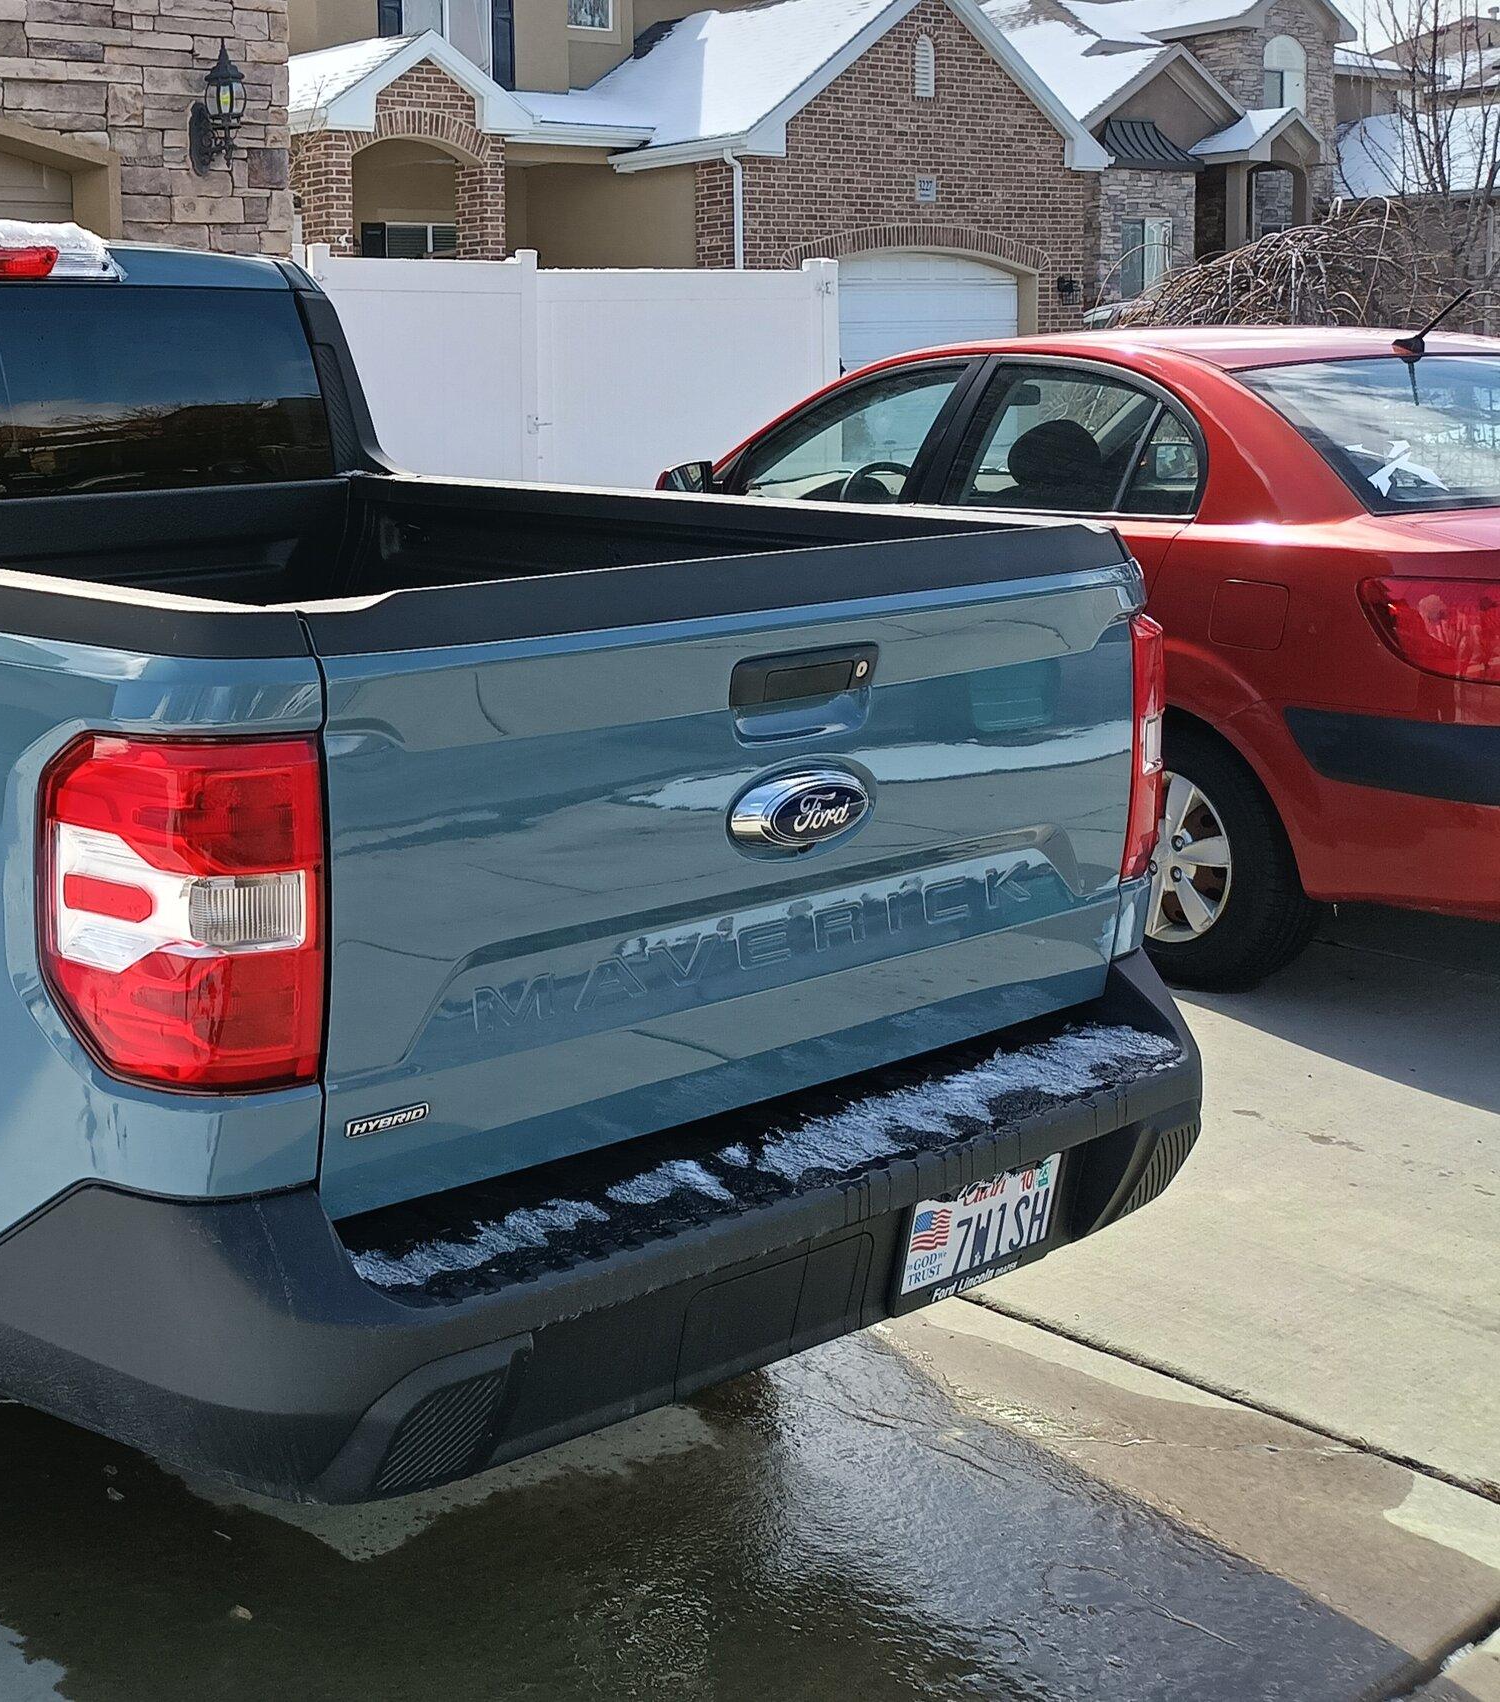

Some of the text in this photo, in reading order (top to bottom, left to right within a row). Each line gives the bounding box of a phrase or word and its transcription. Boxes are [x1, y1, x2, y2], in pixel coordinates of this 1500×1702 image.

[793, 791, 851, 833] Ford
[473, 859, 1032, 1034] MAVERICK
[352, 1107, 425, 1135] HYBRID
[907, 1263, 942, 1286] TRUST
[913, 1252, 938, 1271] GOD
[932, 1281, 957, 1303] Ford
[957, 1268, 995, 1293] Lincoln
